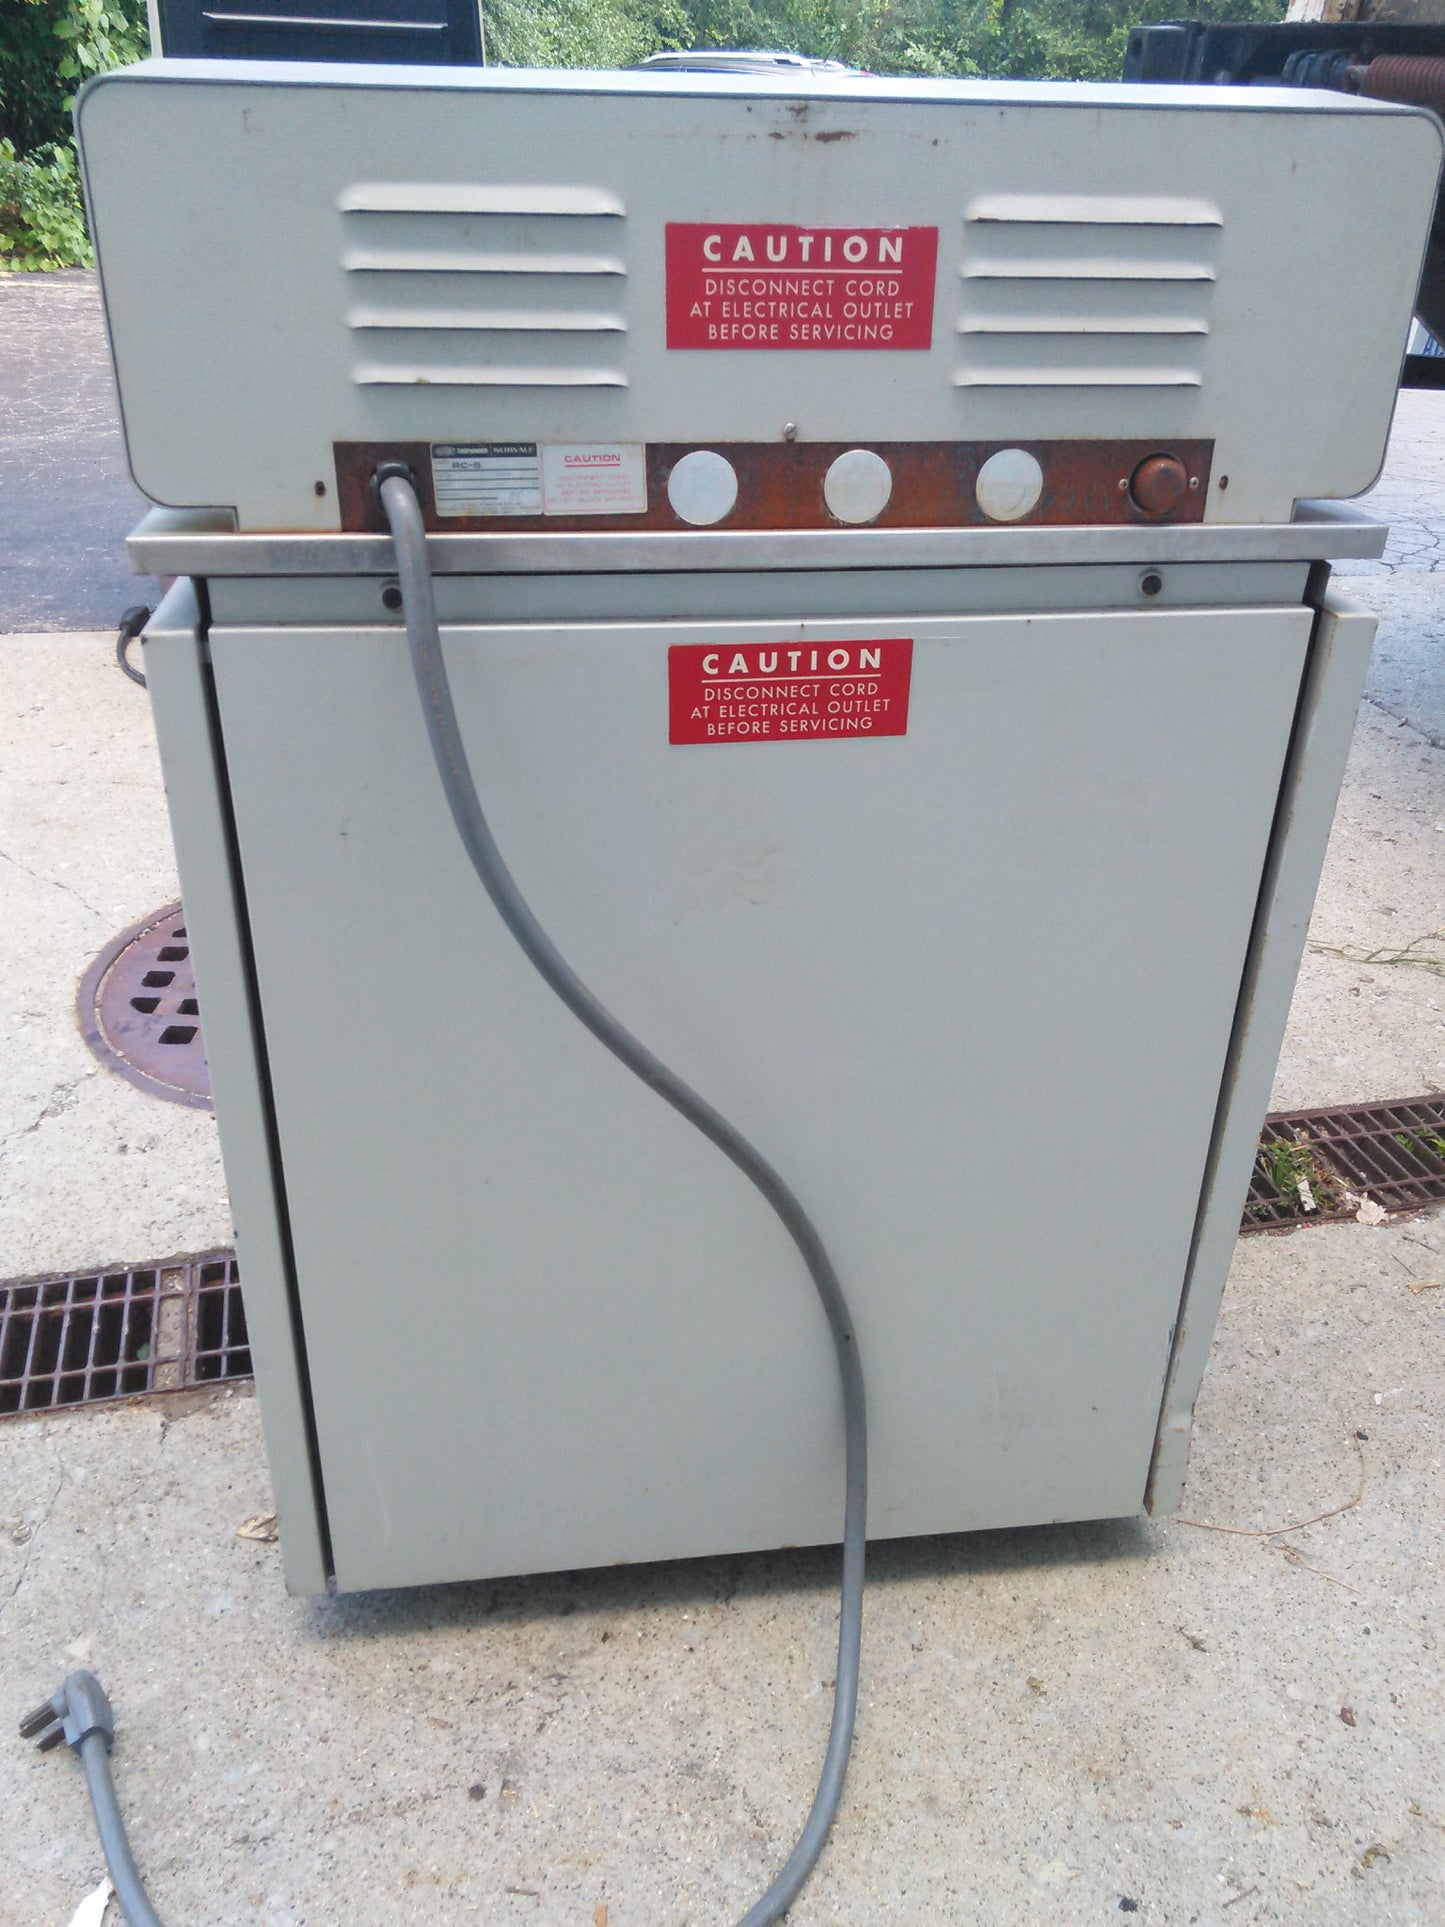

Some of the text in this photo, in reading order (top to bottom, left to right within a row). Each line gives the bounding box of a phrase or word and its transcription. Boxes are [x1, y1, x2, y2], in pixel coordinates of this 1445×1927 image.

[703, 234, 903, 263] CAUTION
[705, 279, 900, 297] DISCONNECT CORD
[690, 302, 914, 319] AT ELECTRICAL OUTLET
[708, 323, 894, 340] BEFORE SERVICING
[564, 454, 621, 463] CAUTION
[701, 648, 882, 675] CAUTION
[704, 682, 879, 702] DISCONNECT CORD
[690, 698, 891, 719] AT ELECTRICAL OUTLET
[707, 716, 873, 736] BEFORE SERVICING
